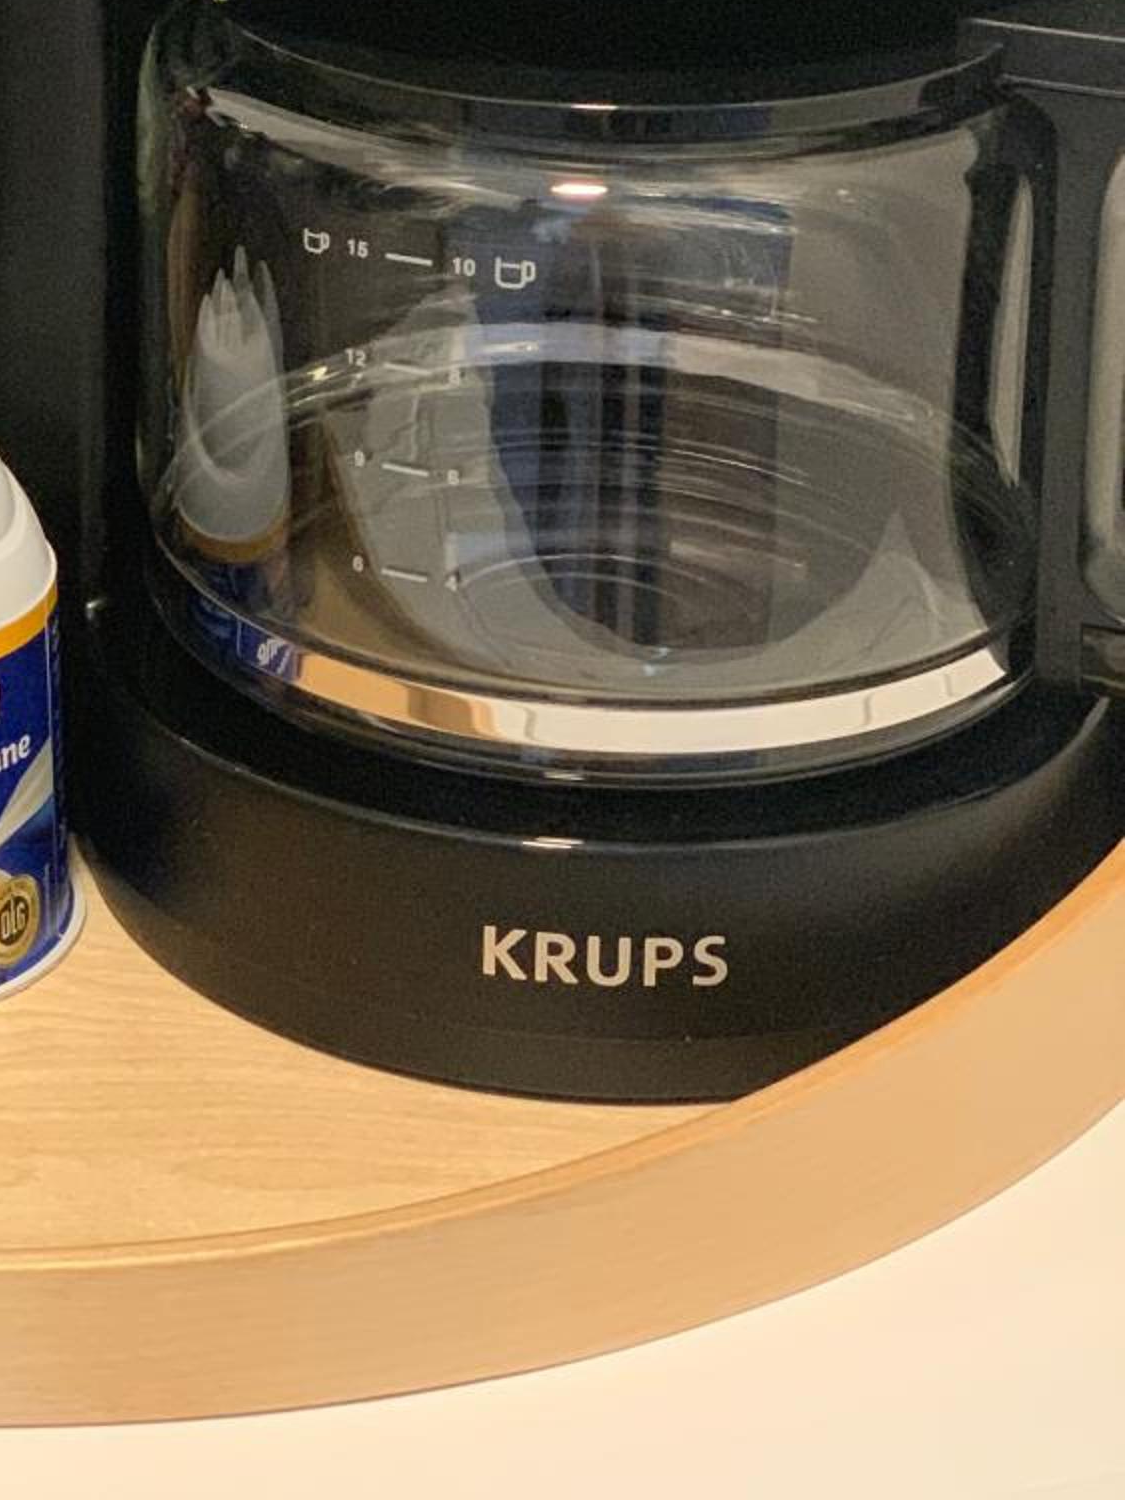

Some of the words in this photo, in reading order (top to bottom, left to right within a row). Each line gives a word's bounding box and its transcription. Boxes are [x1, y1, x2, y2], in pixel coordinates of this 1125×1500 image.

[346, 238, 370, 259] 15
[451, 257, 476, 277] 10
[344, 348, 367, 368] 12
[351, 554, 365, 573] 6
[482, 924, 729, 987] KRUPS
